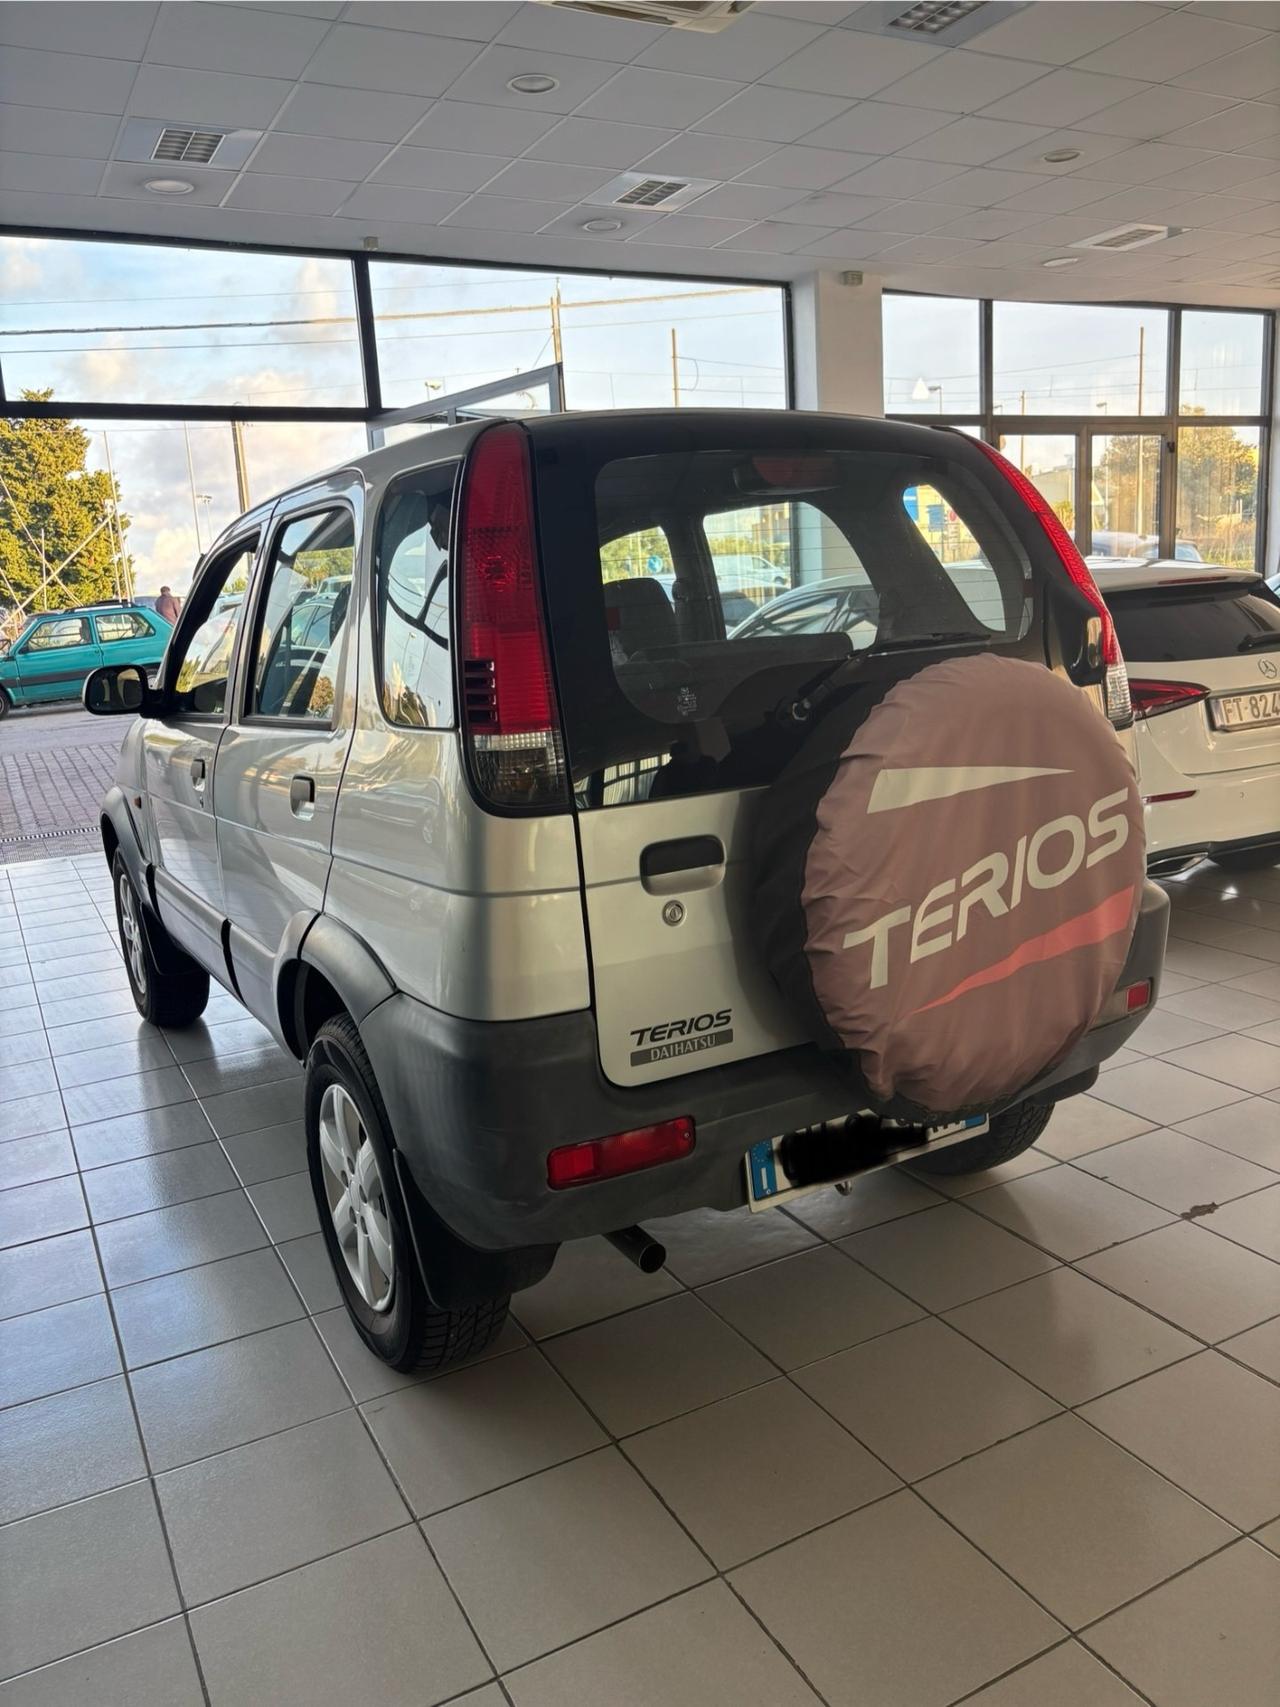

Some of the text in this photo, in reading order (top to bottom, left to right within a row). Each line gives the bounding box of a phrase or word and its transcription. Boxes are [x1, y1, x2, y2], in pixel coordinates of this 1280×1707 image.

[1222, 697, 1243, 724] FT
[842, 787, 1129, 990] TERIOS
[630, 1008, 732, 1046] TERIOS
[650, 1034, 716, 1061] DAIHATSU
